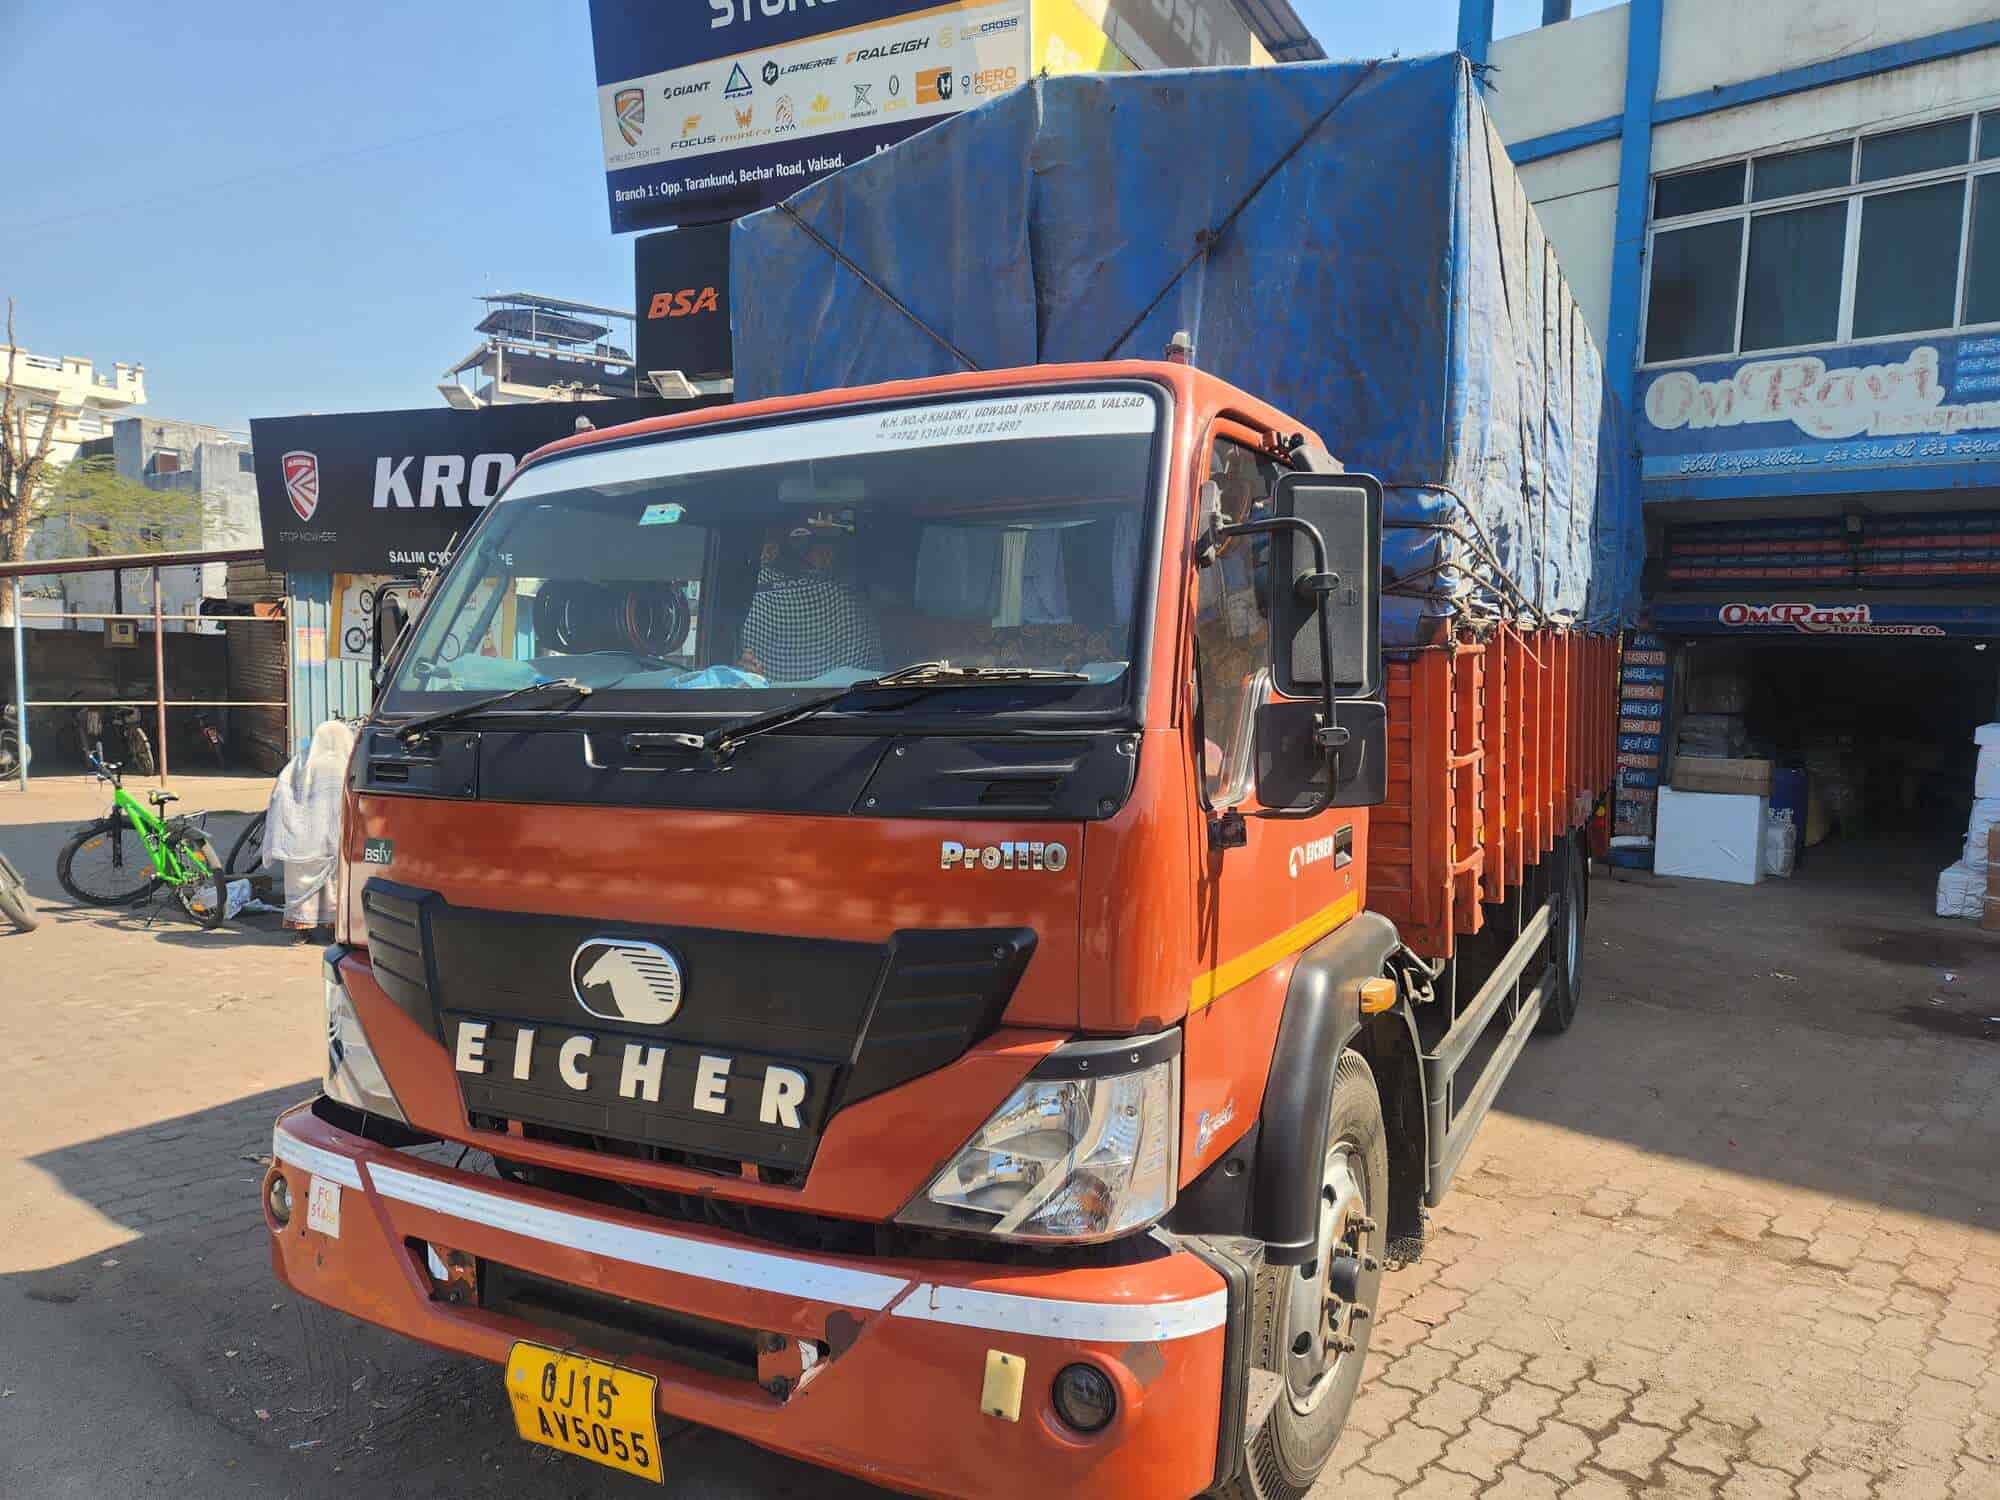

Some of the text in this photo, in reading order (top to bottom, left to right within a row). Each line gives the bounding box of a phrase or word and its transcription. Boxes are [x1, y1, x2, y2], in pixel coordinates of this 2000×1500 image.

[856, 37, 931, 62] RALEIGH
[780, 56, 839, 76] LAPIERRE
[975, 67, 1017, 82] HERO
[673, 80, 712, 97] GIANT
[670, 135, 717, 150] FOCUS
[615, 186, 646, 202] Branch
[660, 180, 684, 196] Opp.
[685, 173, 738, 191] Tarankund,
[740, 167, 774, 183] Bechar
[776, 160, 806, 177] Road,
[807, 153, 846, 172] Valsad.
[647, 287, 719, 320] BSA
[1101, 396, 1145, 409] VALSAD
[388, 551, 426, 564] SALIM
[1832, 624, 1914, 634] TRANSPORT
[455, 1021, 806, 1129] EICHER
[537, 1407, 650, 1468] AV5055
